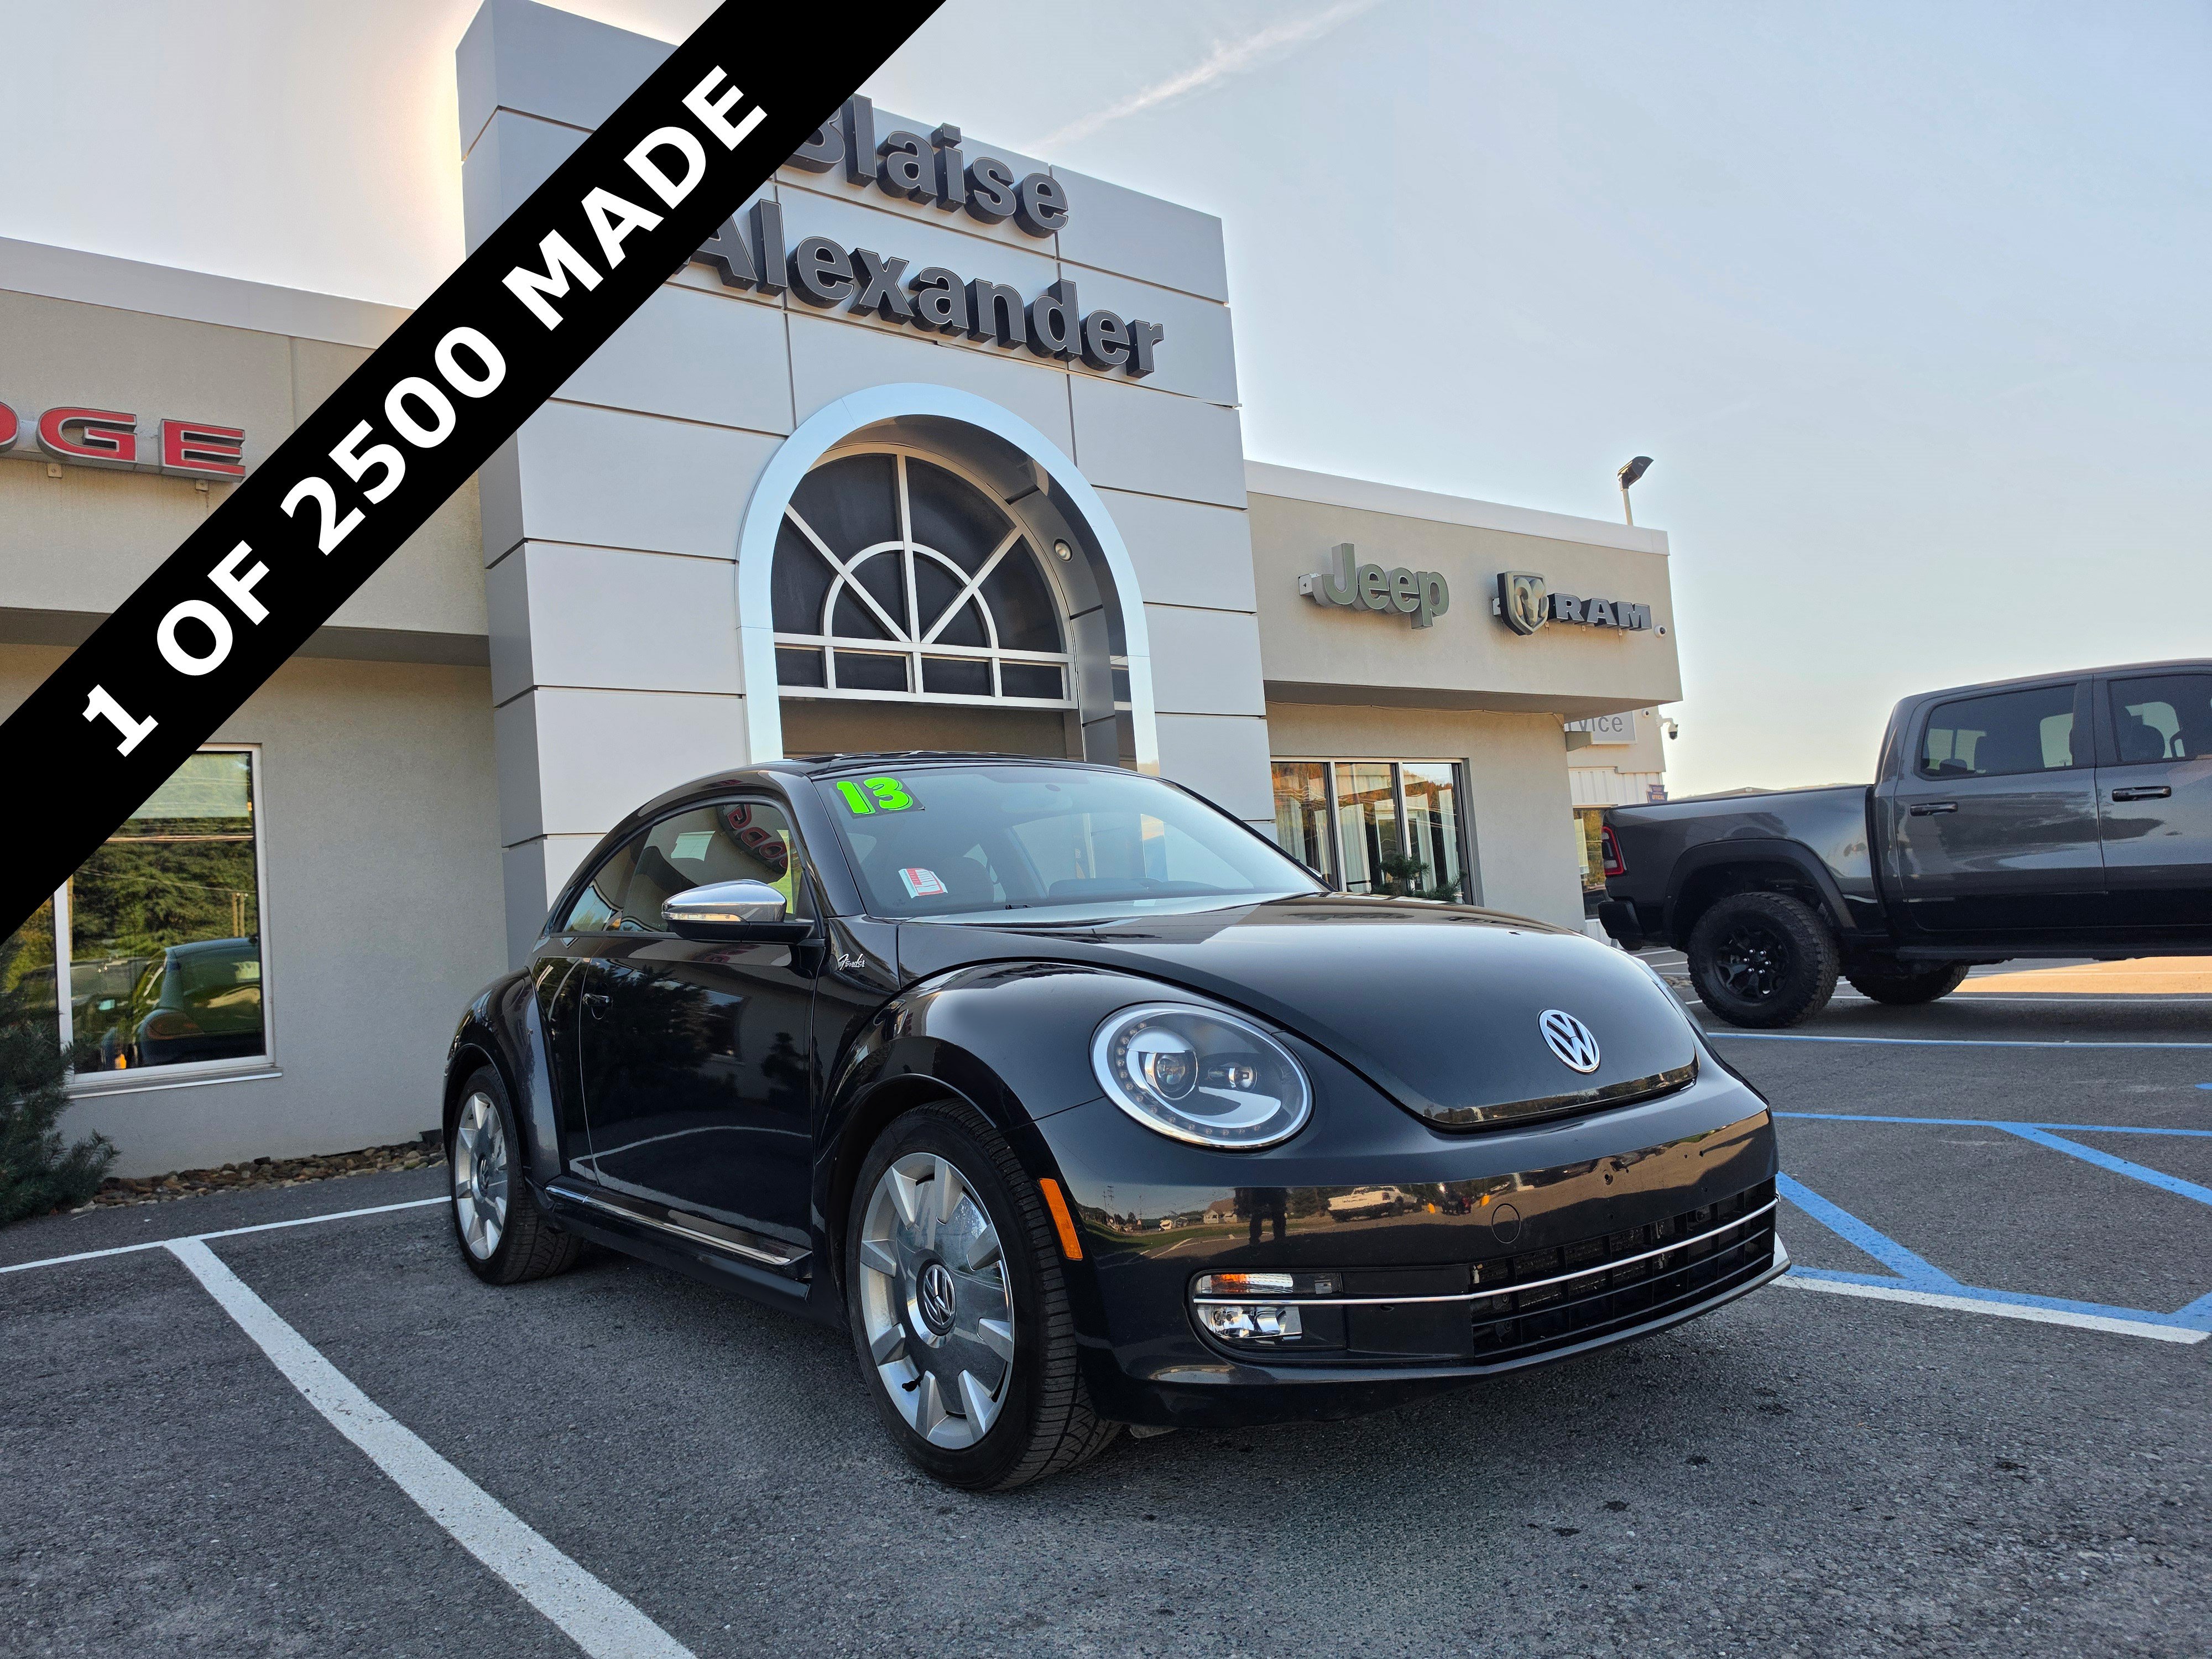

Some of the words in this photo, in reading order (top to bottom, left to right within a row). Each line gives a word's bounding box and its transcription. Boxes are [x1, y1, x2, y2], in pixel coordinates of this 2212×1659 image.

[0, 401, 246, 482] GE
[1312, 542, 1449, 629] Jeep
[1547, 593, 1652, 631] RAM
[837, 777, 913, 815] 13
[838, 953, 865, 971] Fender
[1539, 1009, 1600, 1073] VW
